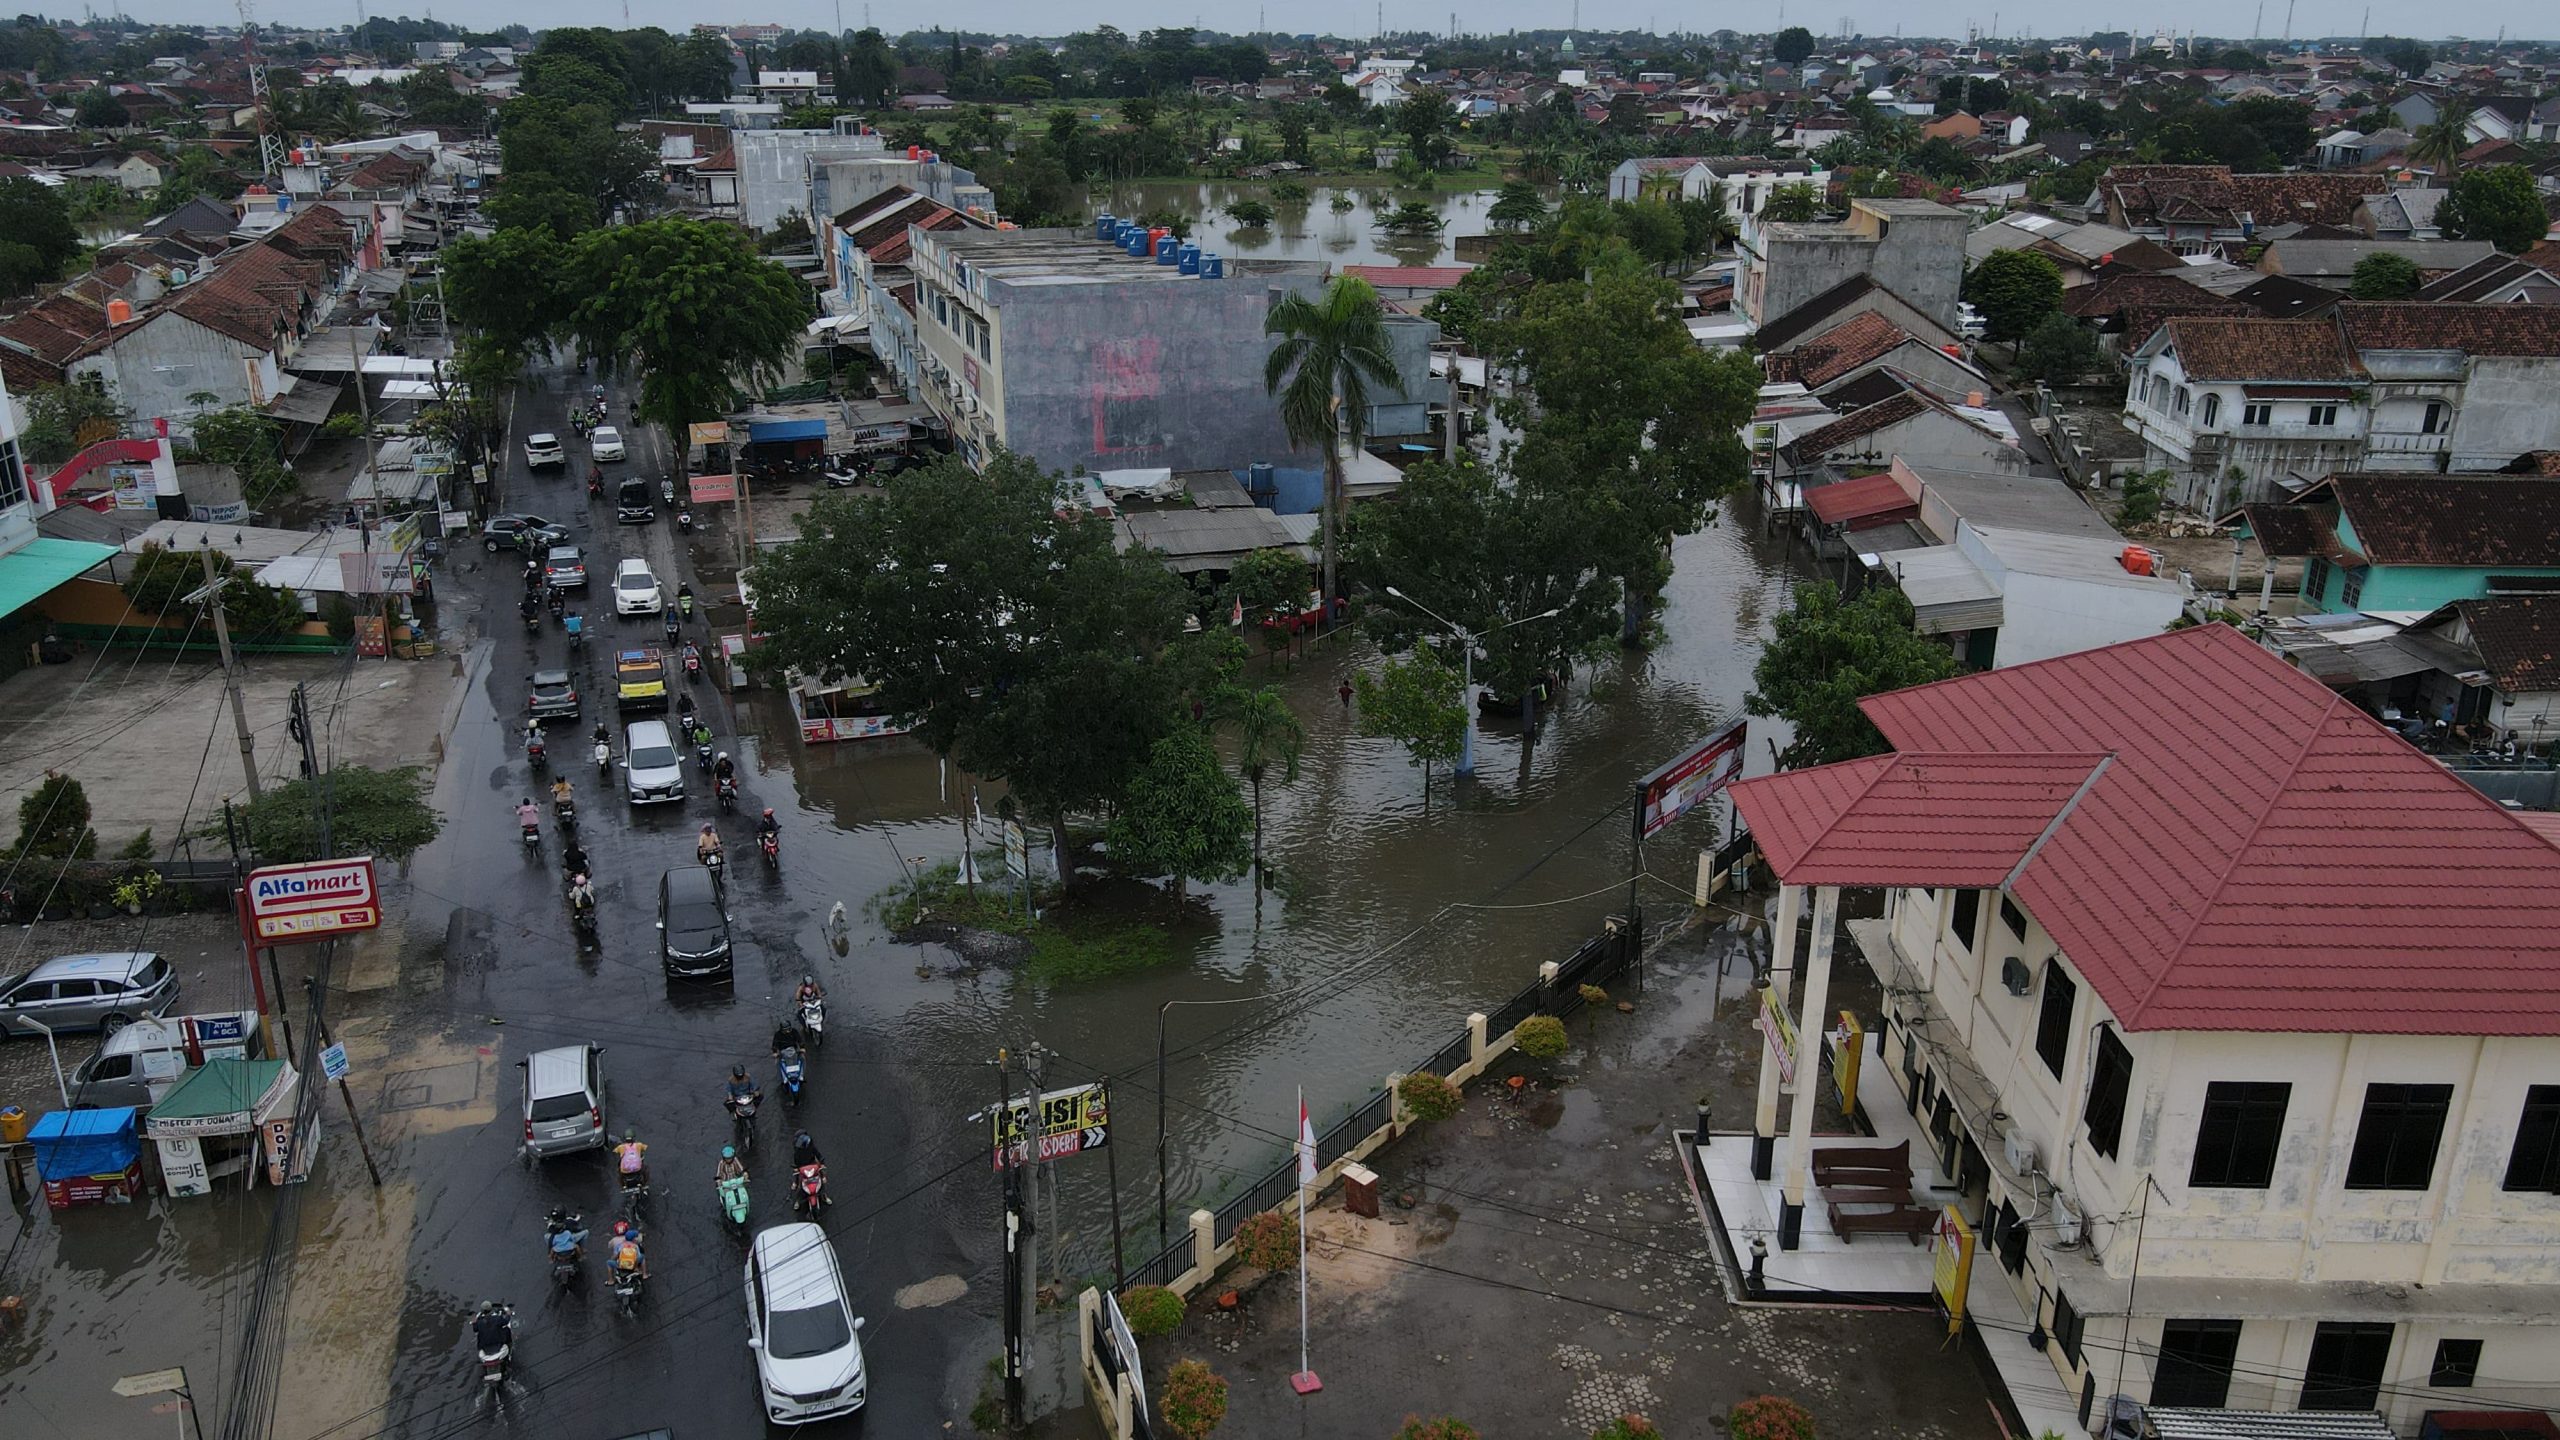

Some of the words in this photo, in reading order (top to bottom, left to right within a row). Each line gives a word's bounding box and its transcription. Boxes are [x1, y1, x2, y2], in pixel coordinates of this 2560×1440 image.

[211, 504, 240, 514] NIPPON
[214, 511, 236, 520] PAINT
[258, 872, 361, 897] Alfamart
[998, 1097, 1078, 1136] POISI
[1039, 1131, 1078, 1158] ODERN
